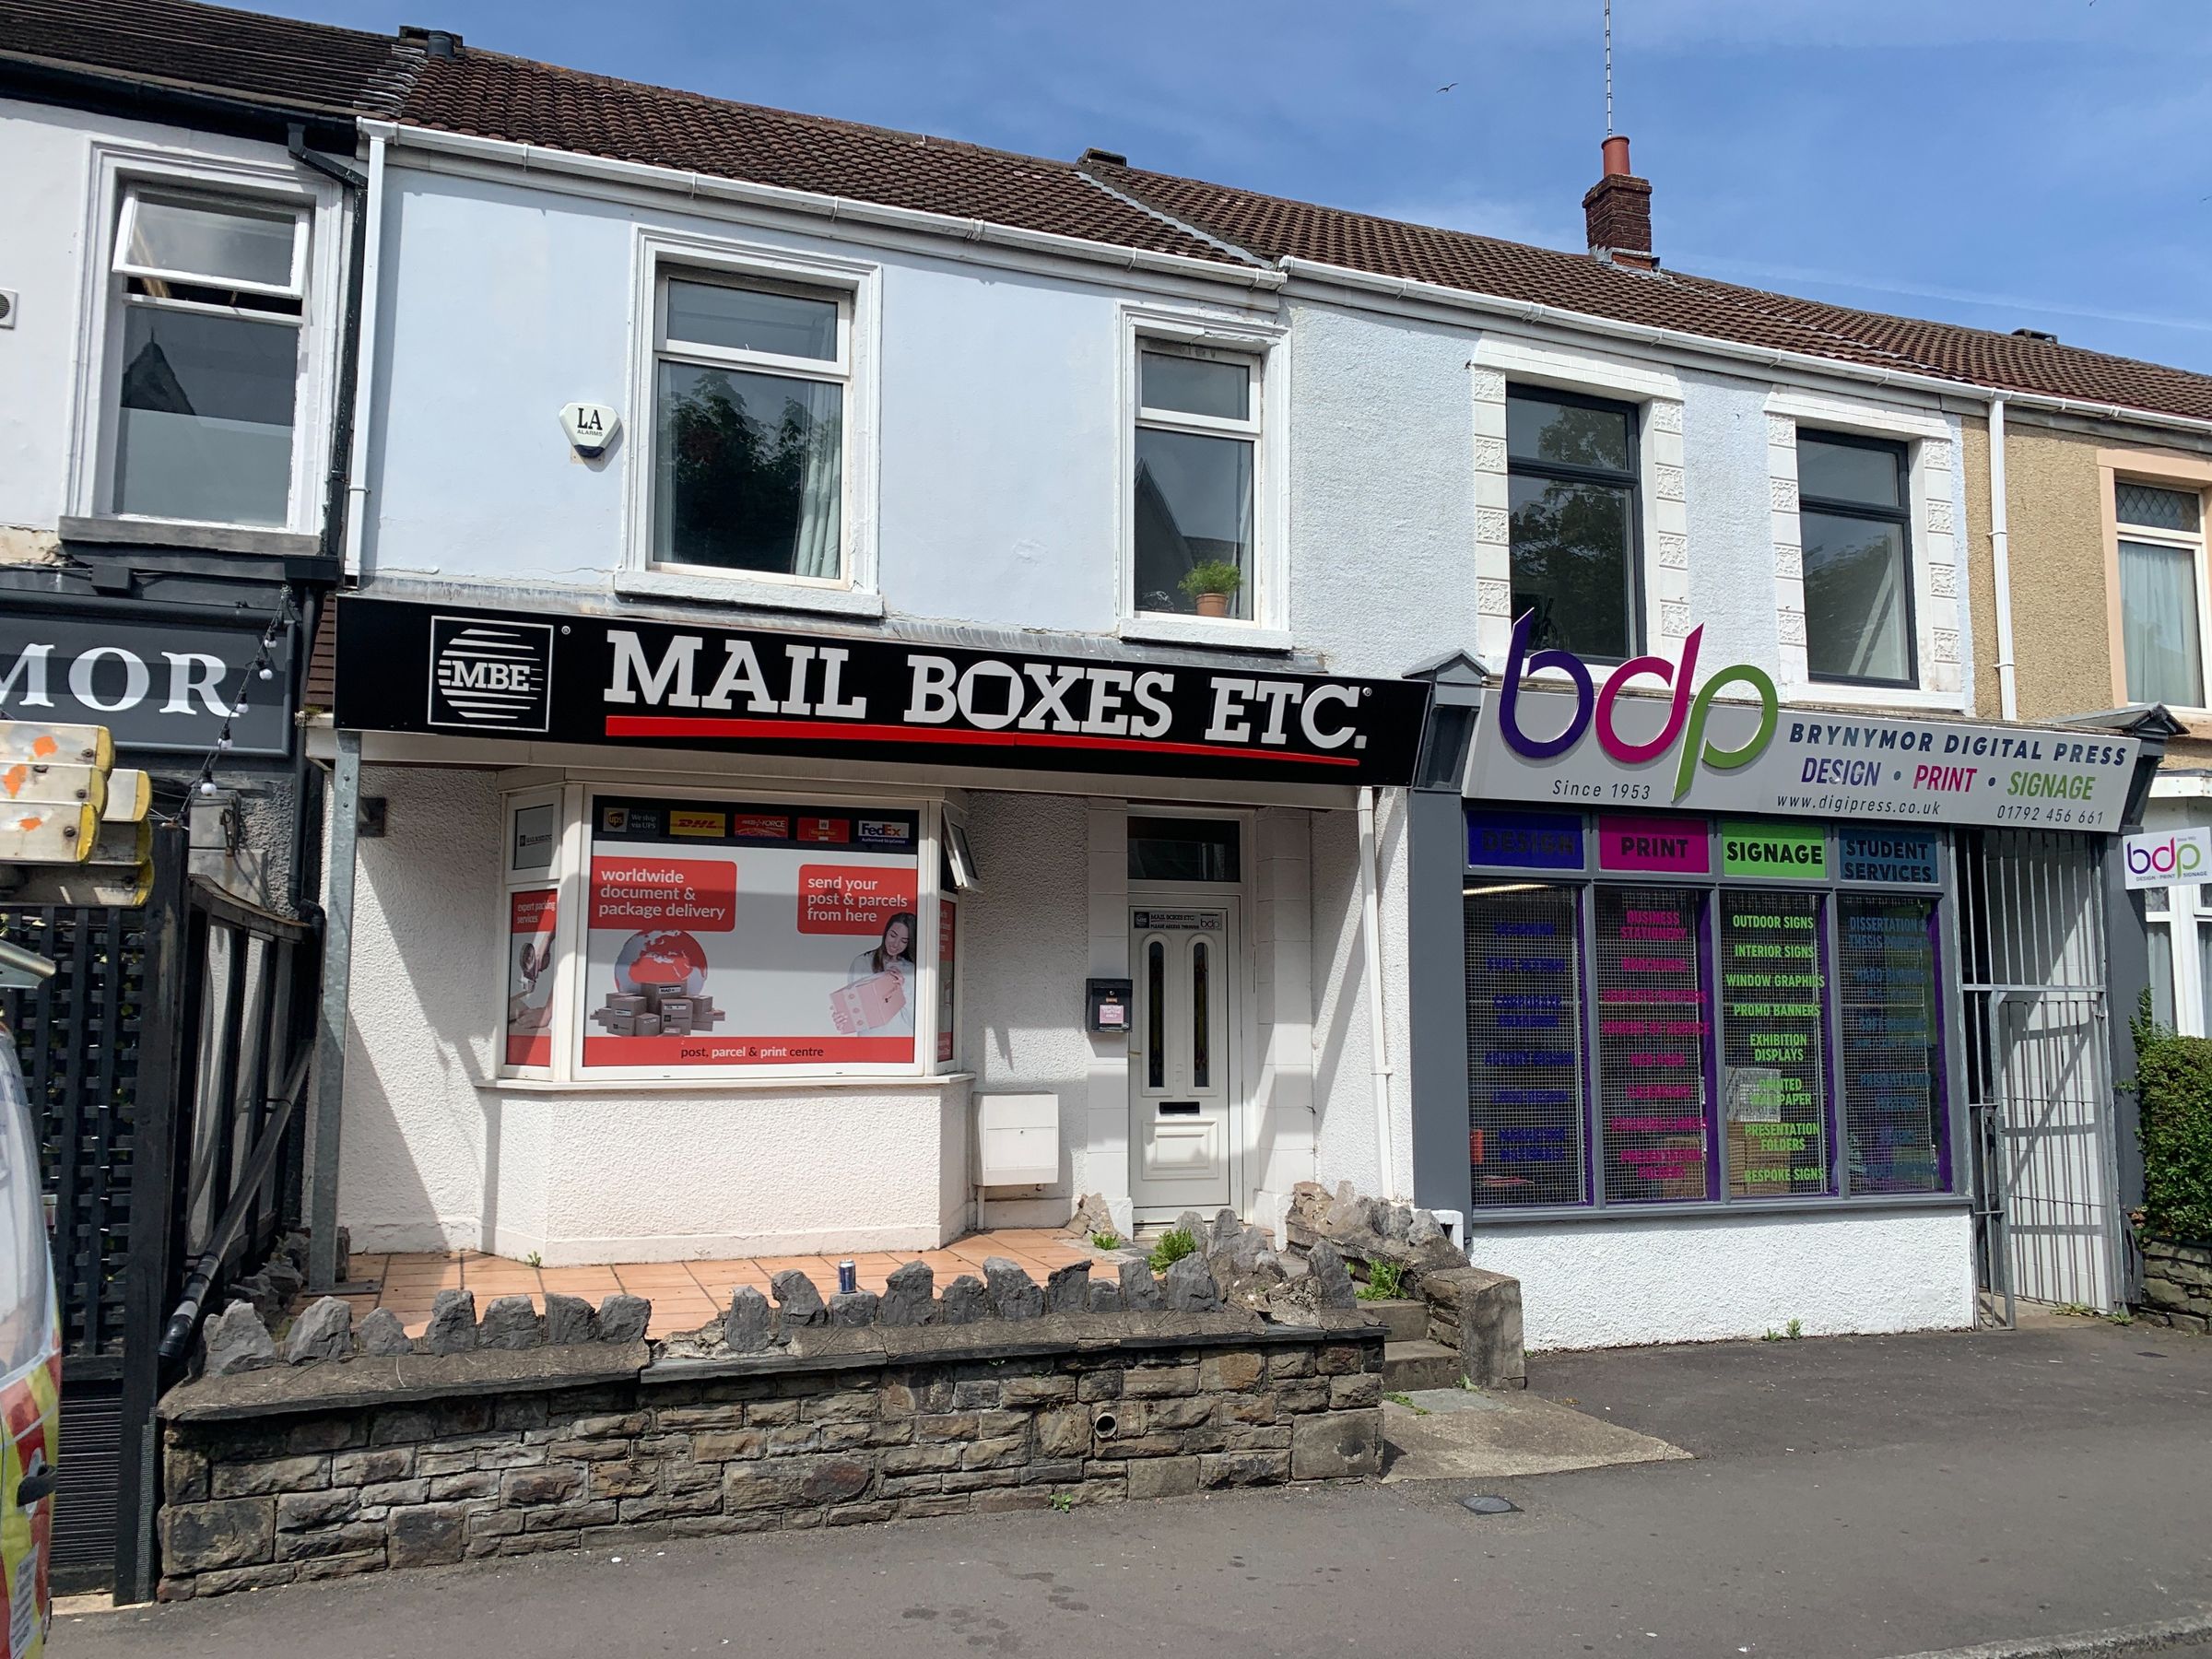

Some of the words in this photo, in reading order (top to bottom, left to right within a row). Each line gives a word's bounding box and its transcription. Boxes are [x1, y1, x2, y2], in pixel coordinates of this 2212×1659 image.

[577, 407, 603, 430] LA
[577, 429, 603, 437] ALARMS
[450, 660, 530, 692] MBE
[604, 629, 866, 719] MAIL
[903, 654, 1174, 737] BOXES
[1499, 606, 1778, 803] bdp
[1789, 723, 1932, 752] BRYNYMOR
[1944, 735, 2041, 760] DIGITAL
[2053, 742, 2127, 767] PRESS
[1801, 757, 1881, 787] DESIGN
[1912, 764, 1978, 793] PRINT
[2006, 771, 2096, 800] SIGNAGE
[1552, 780, 1602, 797] Since
[1611, 783, 1651, 800] 1953
[1777, 794, 1940, 816] www.digipress.co.uk
[608, 815, 623, 826] ups
[1996, 804, 2039, 821] 01792
[2046, 807, 2072, 823] 456
[2077, 810, 2104, 825] 661
[678, 818, 717, 829] DHL
[862, 822, 900, 837] FedEx
[1482, 830, 1575, 856] DESIGN
[1620, 836, 1689, 858] PRINT
[1845, 840, 1928, 861] STUDENT
[1726, 841, 1823, 865] SIGNAGE
[2127, 837, 2201, 879] bdp
[601, 868, 685, 885] worldwide
[1844, 863, 1932, 882] SERVICES
[807, 876, 842, 890] send
[845, 878, 878, 893] your
[600, 885, 680, 900] document
[684, 887, 696, 900] &
[517, 903, 534, 912] expert
[807, 892, 838, 907] post
[843, 893, 855, 905] &
[858, 894, 908, 910] parcels
[598, 901, 662, 919] package
[666, 903, 725, 921] delivery
[807, 909, 841, 922] from
[845, 909, 877, 923] here
[1627, 911, 1680, 924] BUSINESS
[517, 915, 538, 924] services
[1733, 915, 1781, 928] OUTDOOR
[1783, 916, 1814, 929] SIGNS
[1849, 916, 1917, 931] DISSERTATION
[1620, 926, 1687, 940] STATIONERY
[1735, 945, 1782, 958] INTERIOR
[1784, 946, 1814, 959] SIGNS
[1725, 973, 1771, 986] WINDOW
[1774, 975, 1825, 988] GRAPHICS
[1734, 1004, 1771, 1017] PROMO
[1773, 1005, 1821, 1017] BANNERS
[1749, 1033, 1807, 1046] EXHIBITION
[680, 1047, 710, 1059] post,
[712, 1045, 746, 1059] parcel
[748, 1047, 759, 1057] &
[760, 1045, 787, 1059] print
[789, 1047, 824, 1057] centre
[1754, 1048, 1804, 1062] DISPLAYS
[1759, 1078, 1802, 1091] PRINTED
[1745, 1123, 1820, 1136] PRESENTATION
[1760, 1137, 1806, 1151] FOLDERS
[1745, 1169, 1791, 1182] BESPOKE
[1794, 1167, 1824, 1180] SIGNS
